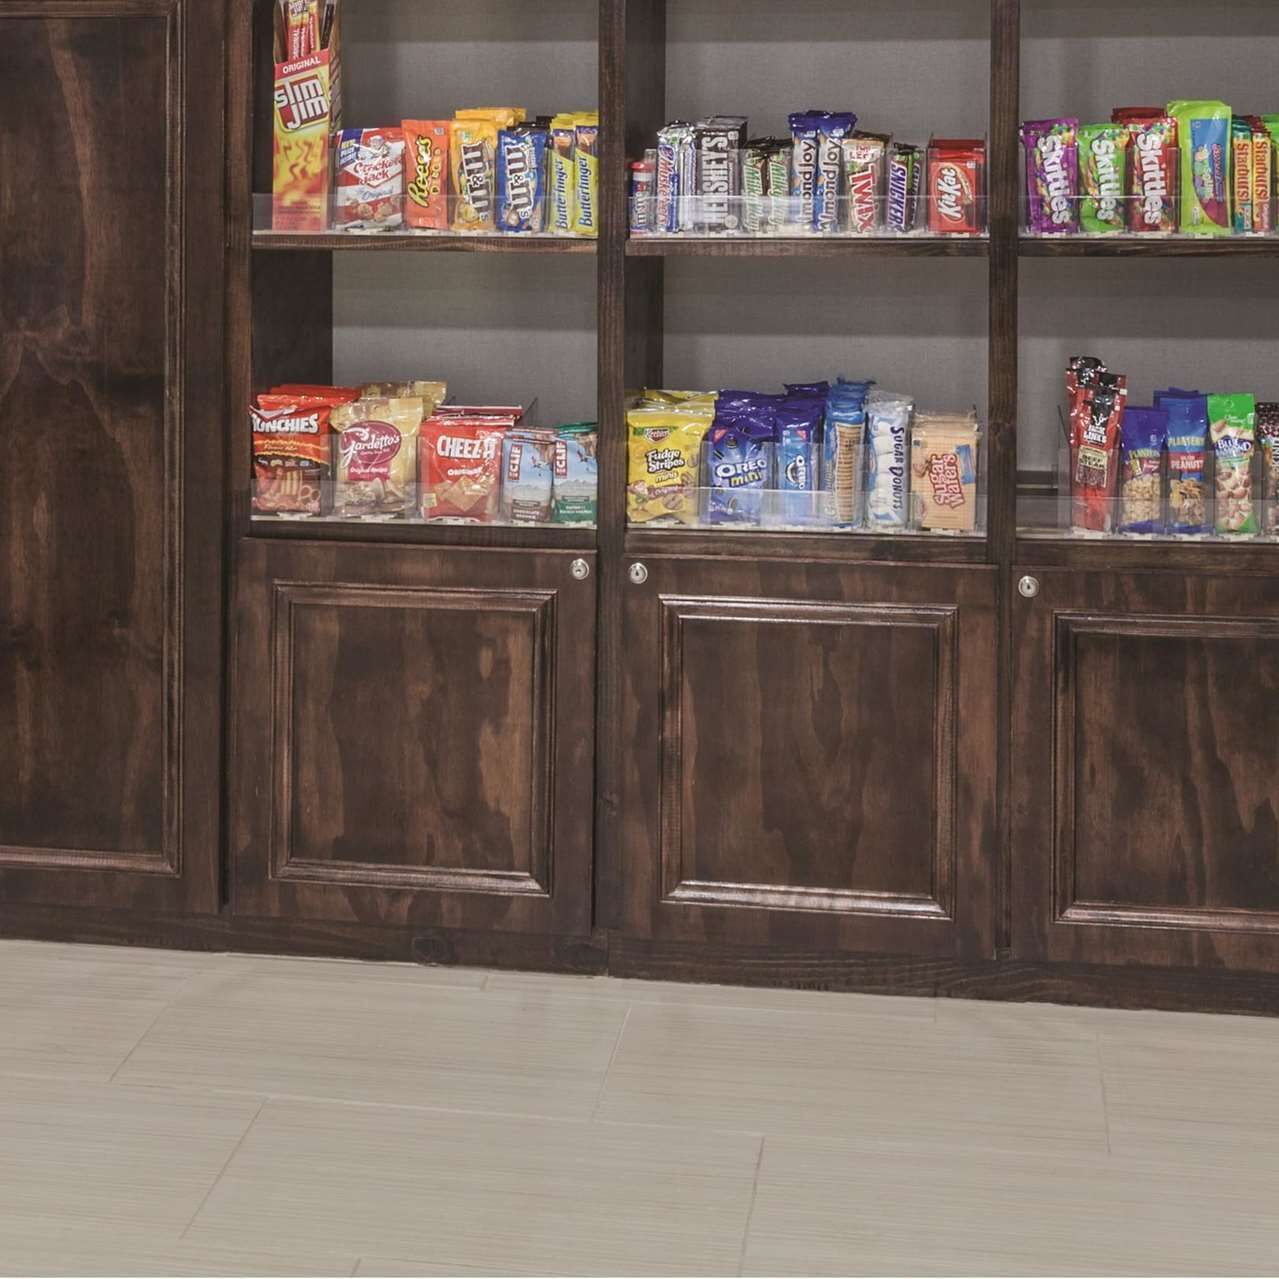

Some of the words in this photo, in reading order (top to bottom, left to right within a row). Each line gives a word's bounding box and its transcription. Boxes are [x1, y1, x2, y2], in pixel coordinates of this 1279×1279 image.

[282, 56, 321, 74] ORIGINAL
[578, 157, 593, 228] Butterfinger
[849, 163, 876, 233] TWIX
[1136, 132, 1167, 225] Skittles
[647, 449, 680, 463] Fudge
[648, 459, 685, 473] Stripes
[890, 426, 904, 466] SUGAR
[716, 459, 767, 477] OREO
[888, 467, 904, 510] DONUTS
[929, 453, 944, 506] Sugar
[943, 452, 965, 509] Wafers
